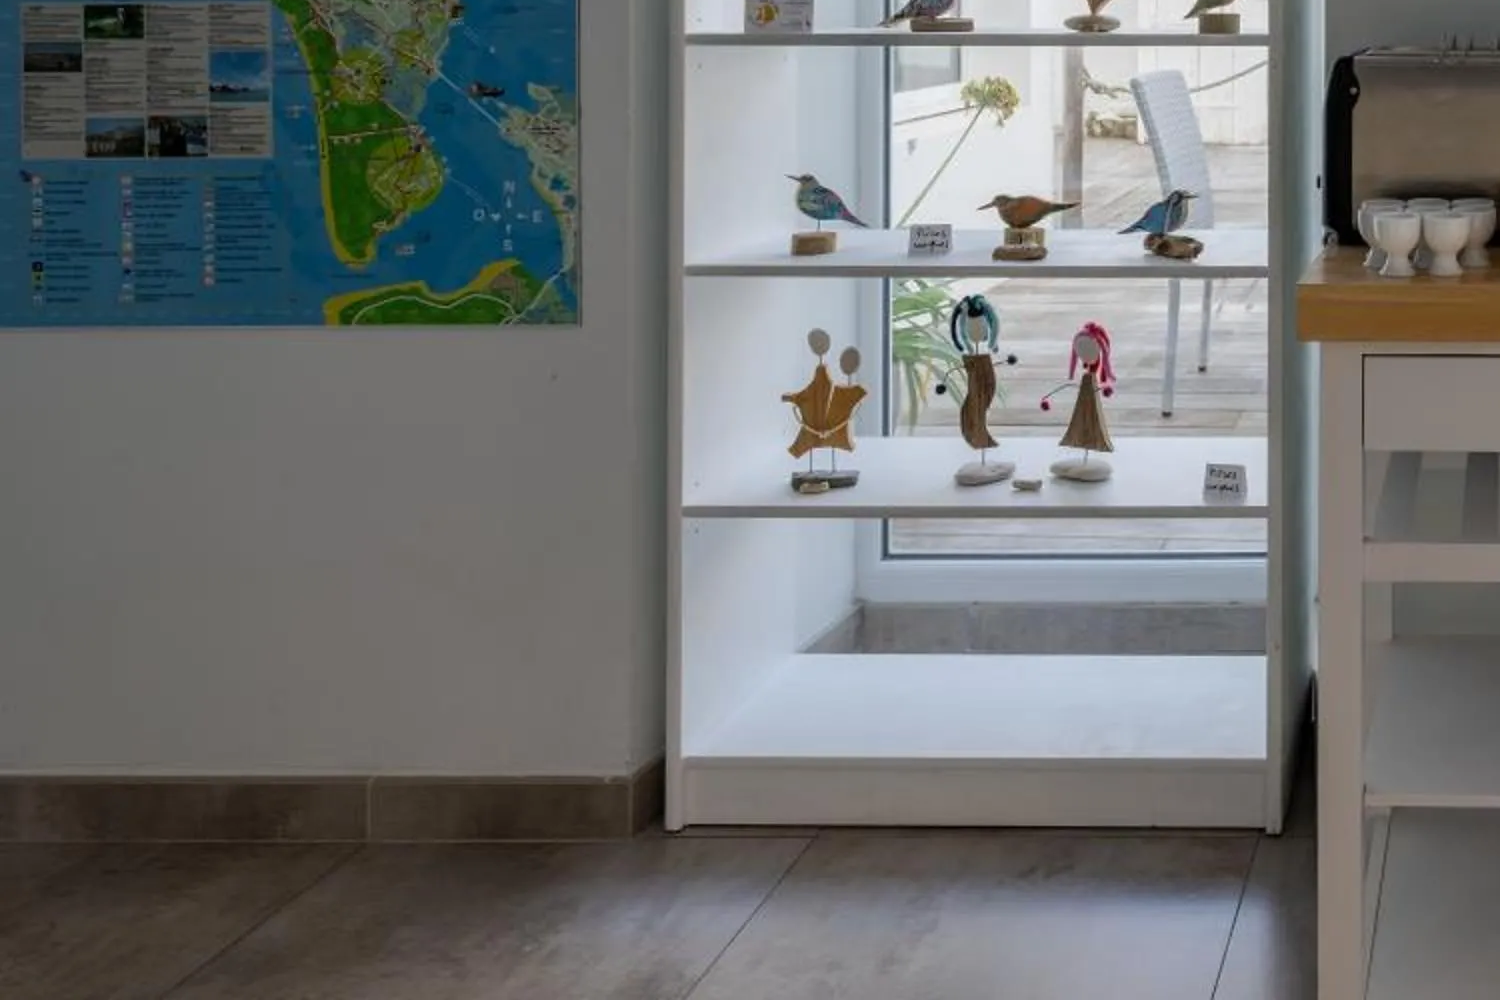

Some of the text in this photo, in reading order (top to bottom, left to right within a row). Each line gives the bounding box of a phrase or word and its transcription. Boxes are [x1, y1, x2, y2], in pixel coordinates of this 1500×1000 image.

[502, 180, 516, 194] N
[472, 208, 485, 222] O
[532, 209, 544, 223] E
